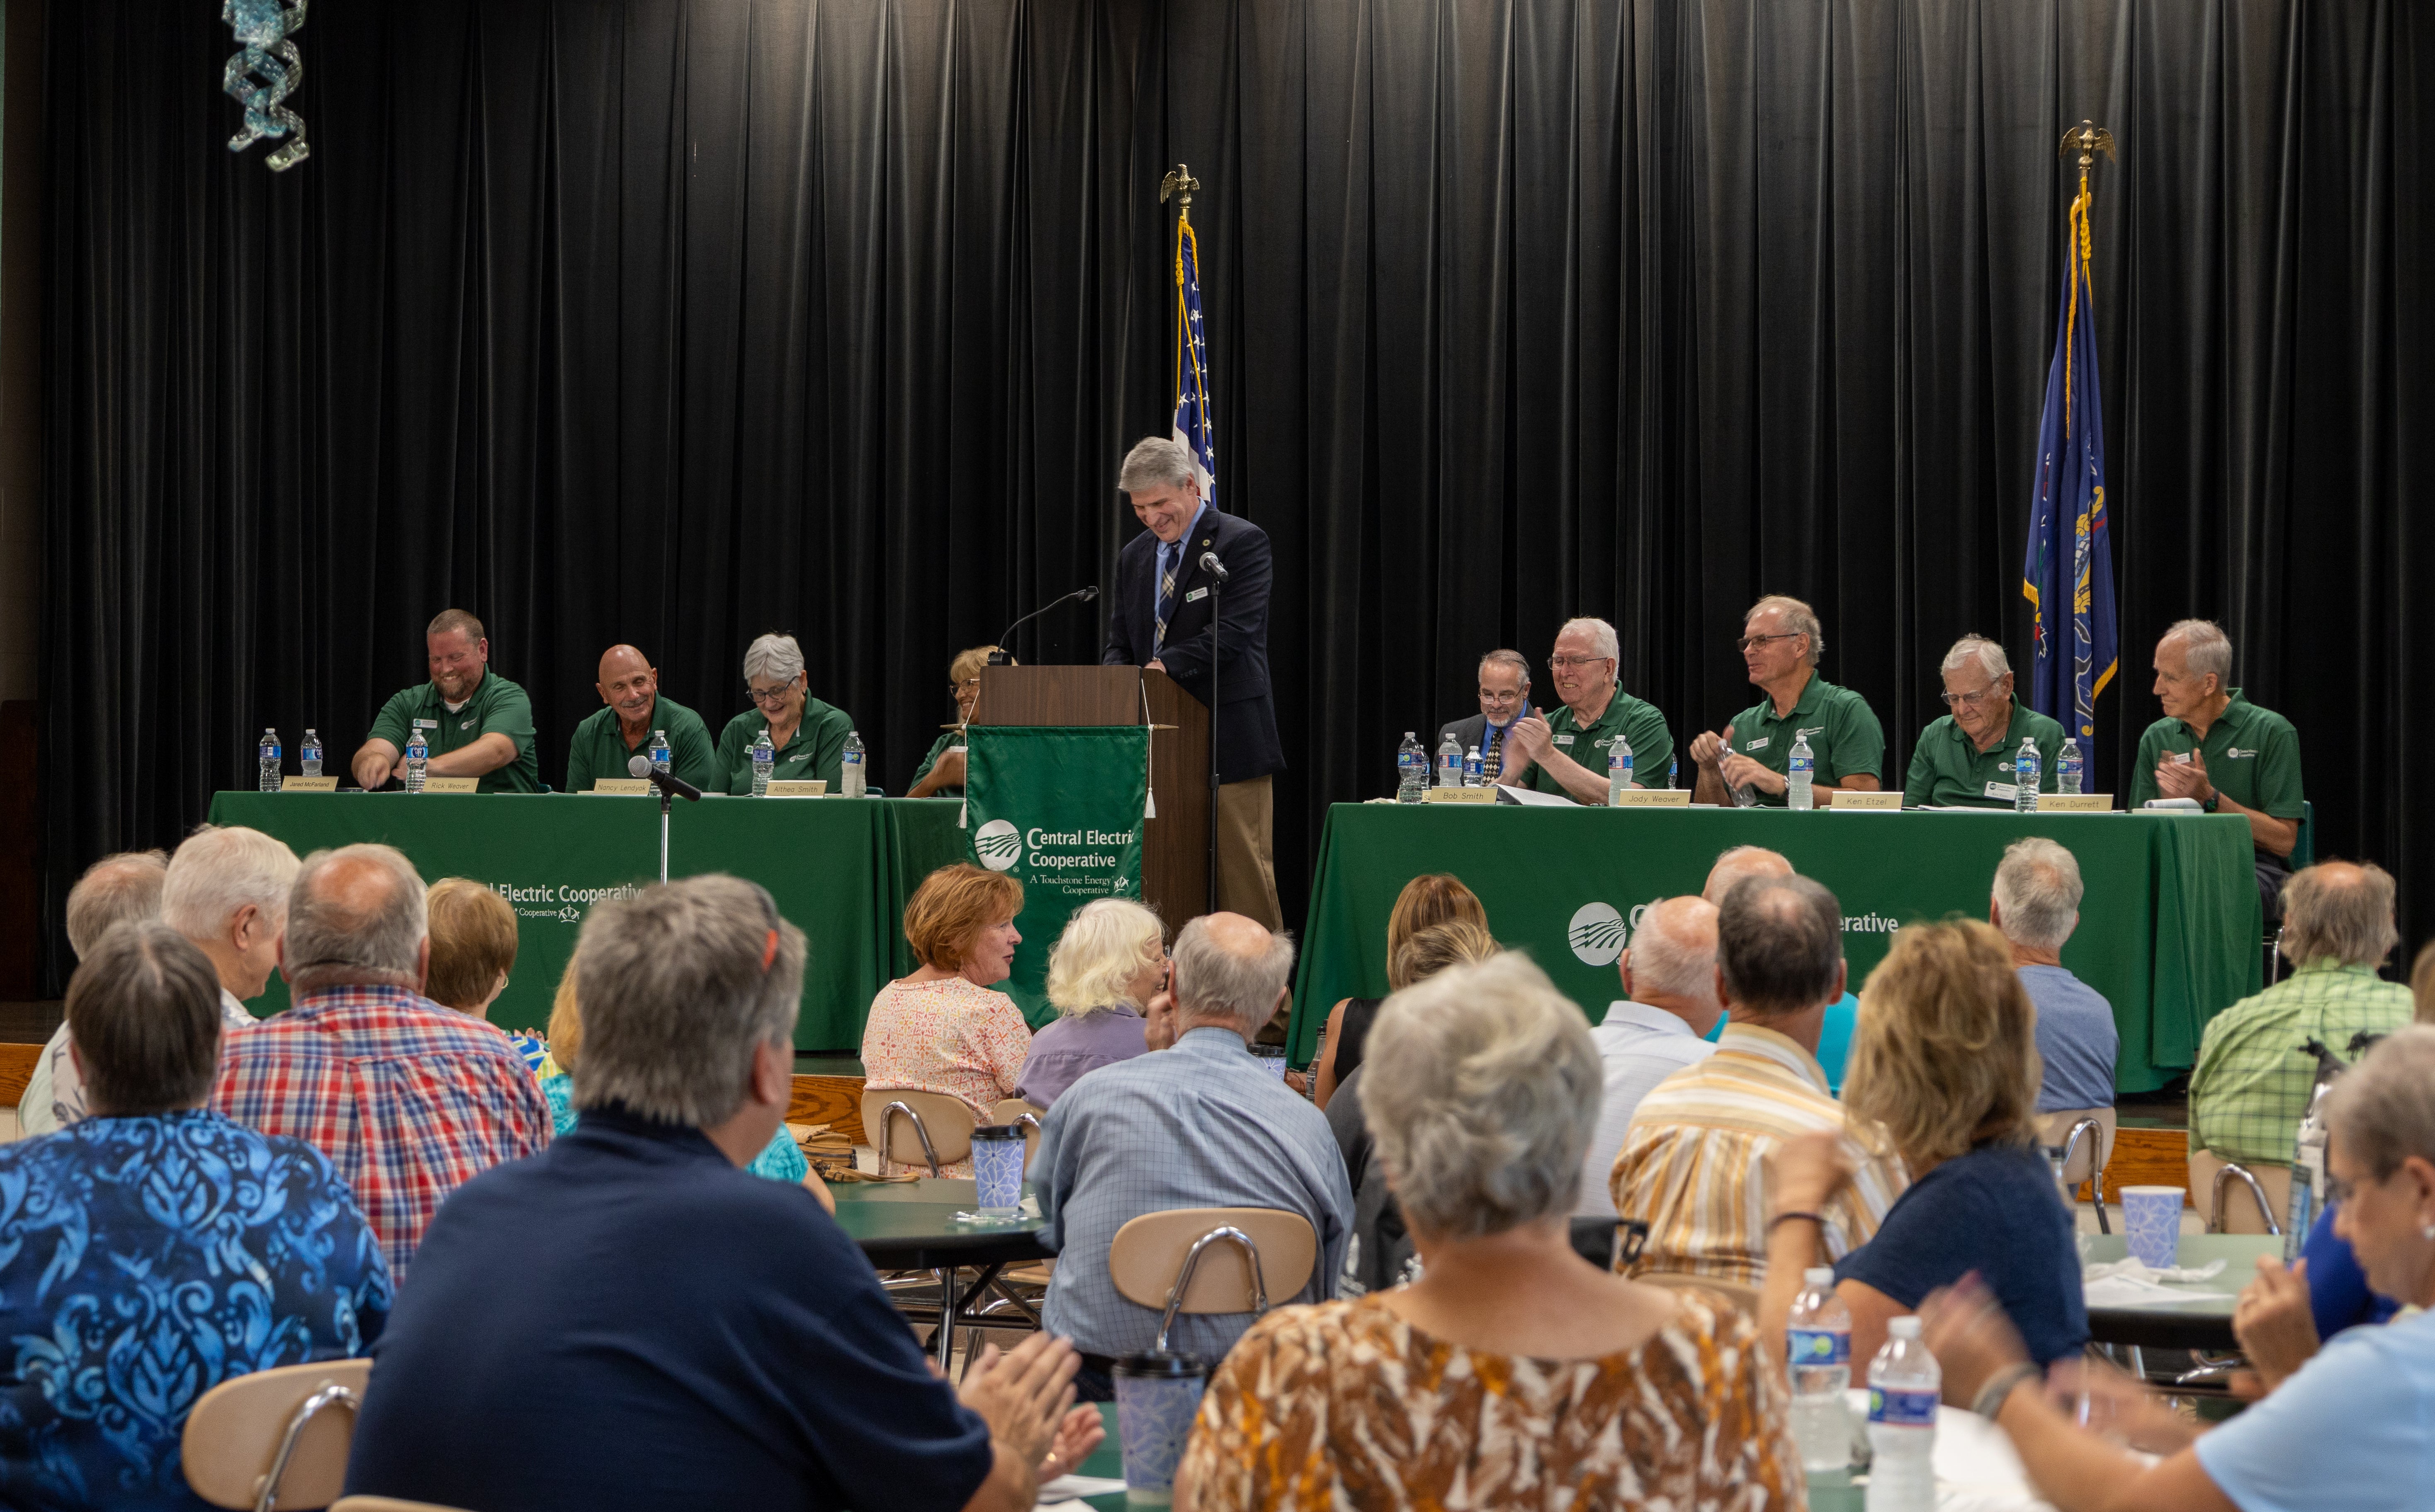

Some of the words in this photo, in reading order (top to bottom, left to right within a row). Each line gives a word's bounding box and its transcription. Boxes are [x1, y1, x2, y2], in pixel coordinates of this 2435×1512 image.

[1629, 795, 1648, 803] Jody
[1027, 828, 1081, 849] Central
[1029, 852, 1116, 870] Cooperative
[1030, 875, 1038, 883] A
[1040, 874, 1083, 884] Touchstone
[499, 883, 554, 902] Electric
[1062, 885, 1109, 894] Cooperative
[519, 908, 557, 918] Cooperative
